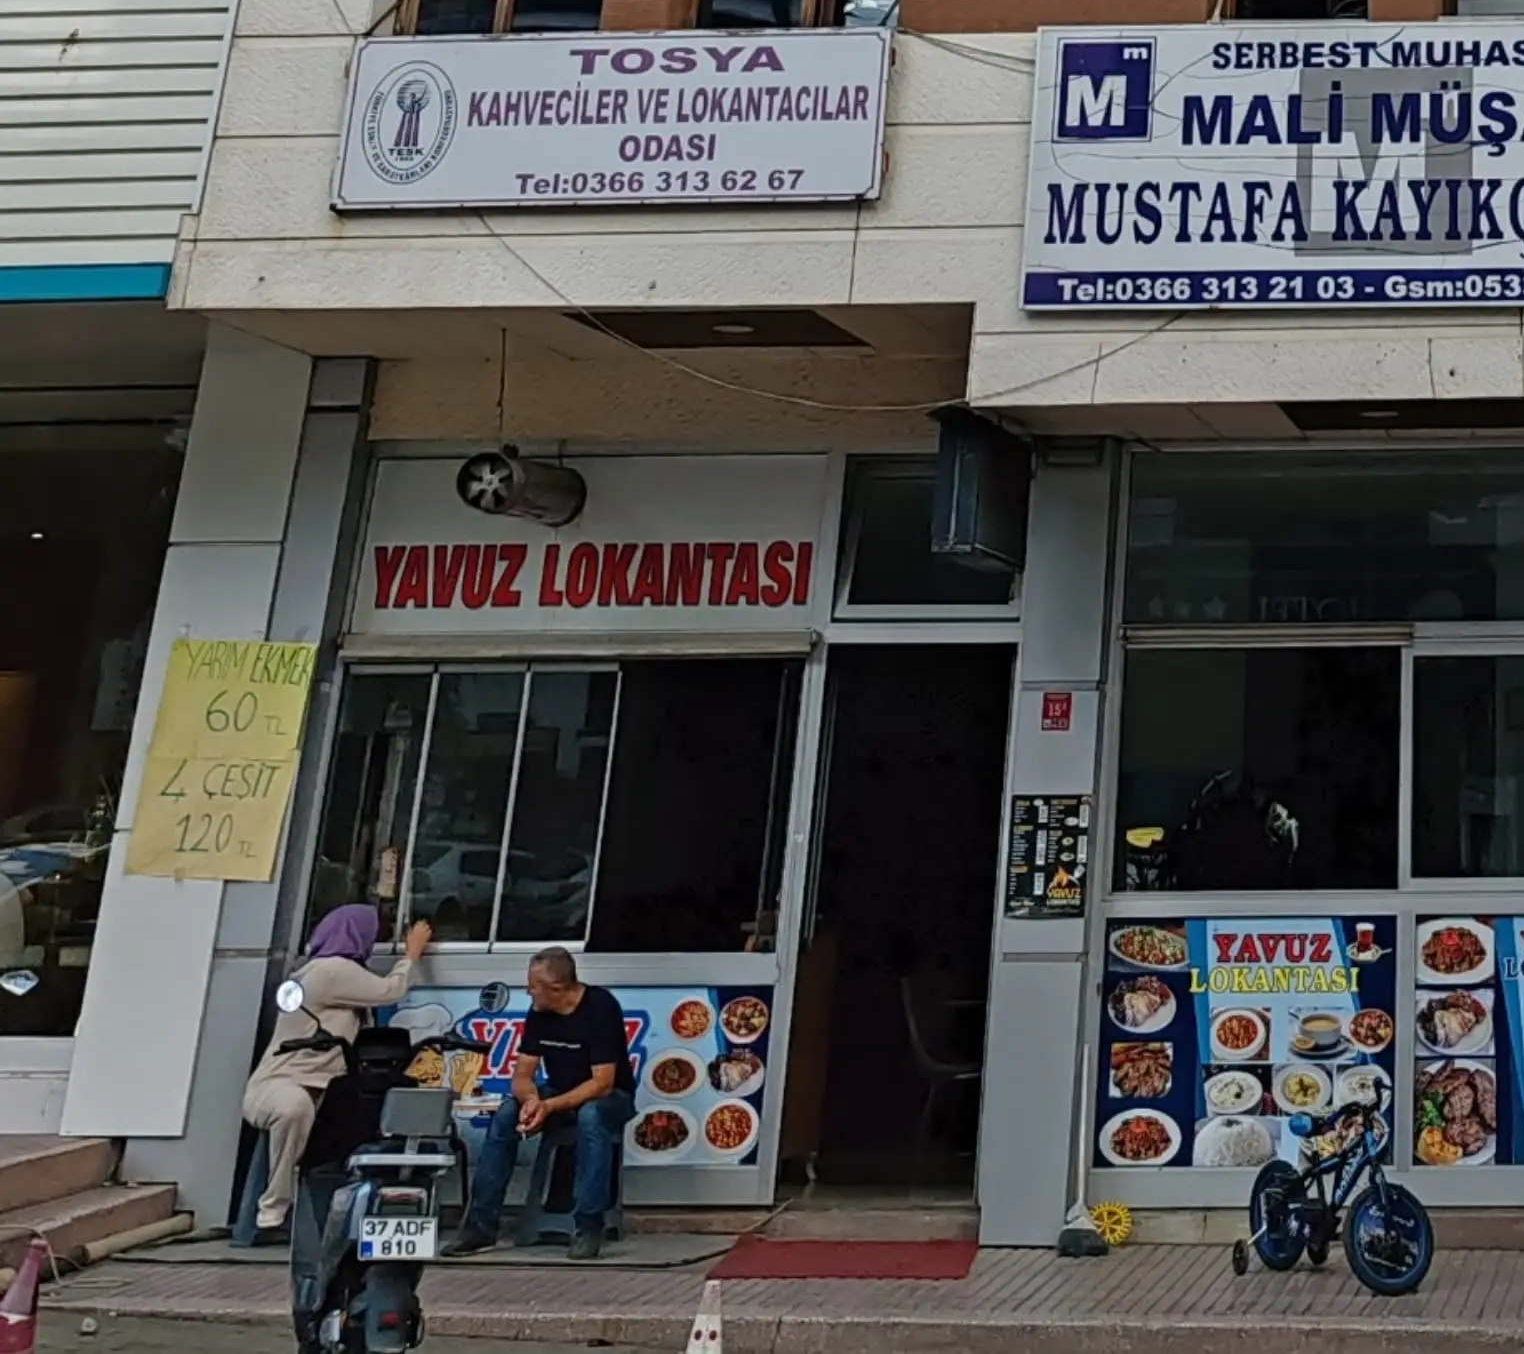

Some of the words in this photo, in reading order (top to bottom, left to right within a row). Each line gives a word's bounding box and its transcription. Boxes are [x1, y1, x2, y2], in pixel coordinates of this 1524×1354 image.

[568, 47, 785, 75] TOSYA
[1211, 41, 1376, 70] SERBEST
[467, 81, 629, 127] KAHVECİLER
[639, 88, 668, 124] VE
[677, 85, 869, 123] LOKANTACILAR
[1181, 81, 1343, 145] MALİ
[618, 134, 716, 162] ODASI
[515, 171, 645, 195] Tel:0366
[655, 170, 710, 193] 313
[720, 170, 759, 192] 62
[768, 169, 805, 191] 67
[1044, 181, 1307, 244] MUSTAFA
[1058, 278, 1191, 302] Tel:0366
[1202, 276, 1259, 300] 313
[1268, 276, 1305, 300] 21
[1316, 275, 1354, 299] 03
[374, 544, 527, 609] YAVUZ
[538, 540, 812, 608] LOKANTASI
[206, 690, 258, 732] 60
[160, 758, 188, 802] 4
[174, 813, 233, 853] 120
[1213, 933, 1331, 963] YAVUZ
[1189, 967, 1359, 994] LOKANTASI
[364, 1220, 389, 1236] 37
[394, 1219, 433, 1237] ADF
[380, 1239, 416, 1257] 810
